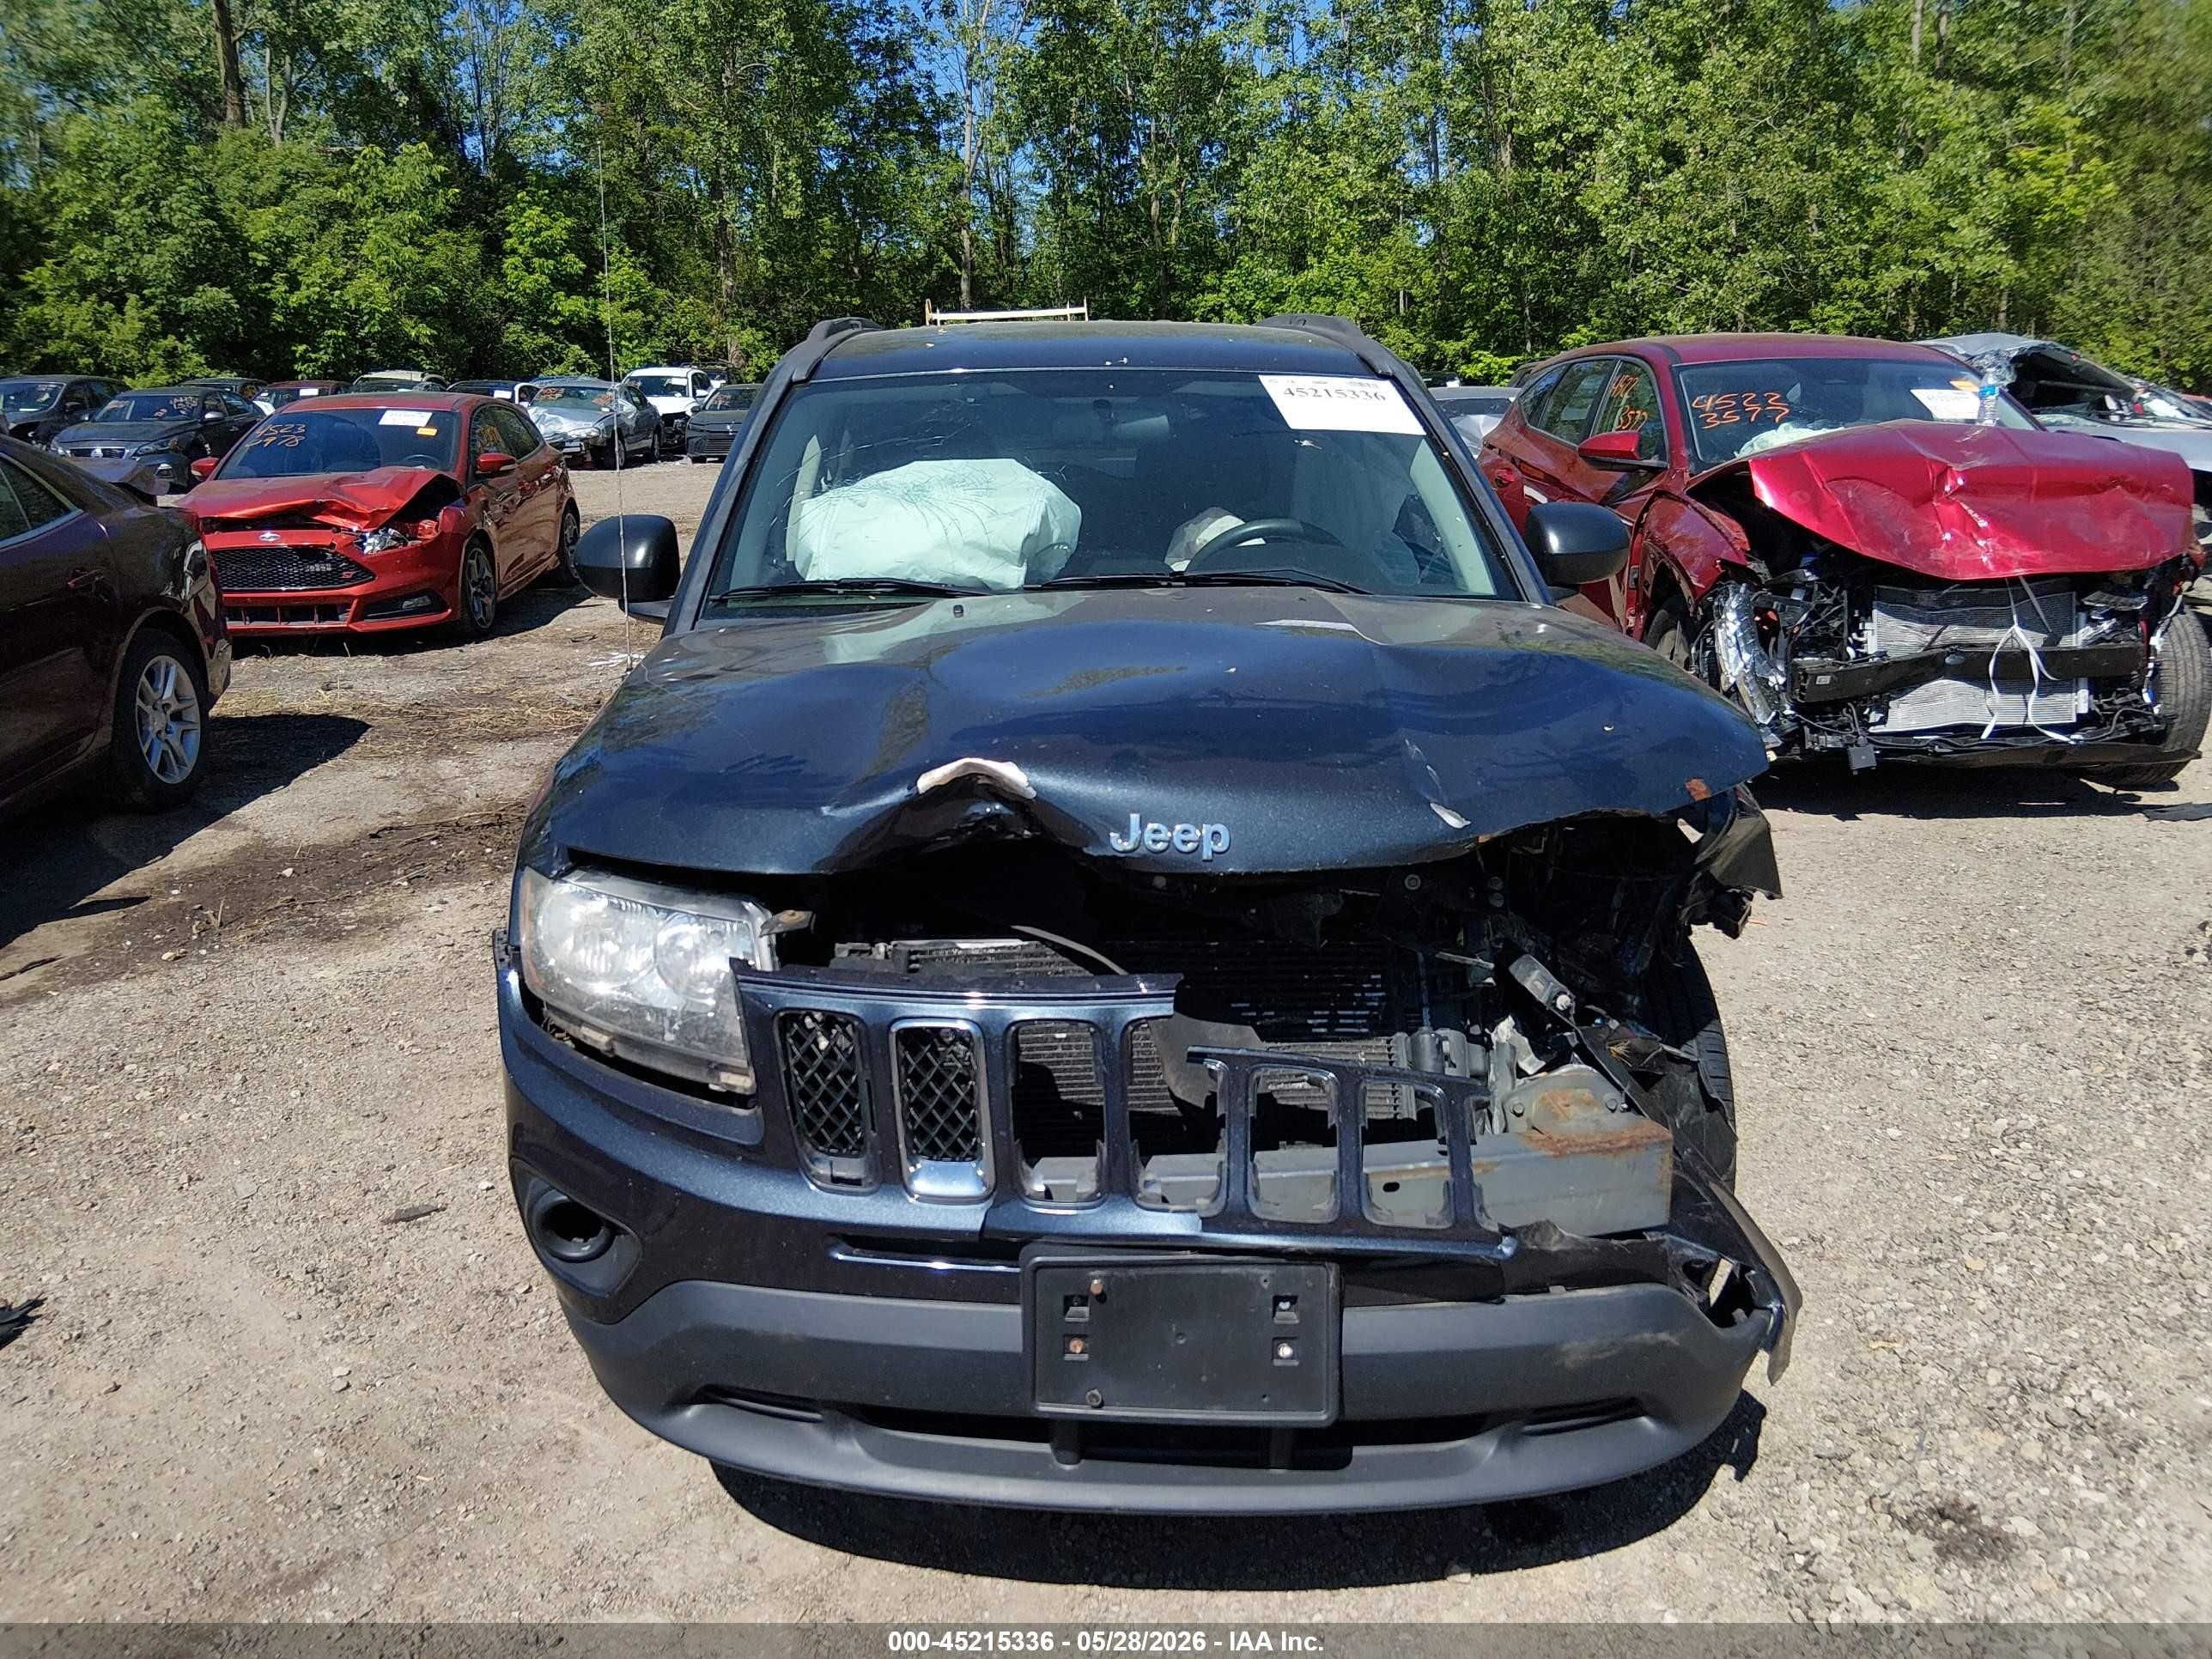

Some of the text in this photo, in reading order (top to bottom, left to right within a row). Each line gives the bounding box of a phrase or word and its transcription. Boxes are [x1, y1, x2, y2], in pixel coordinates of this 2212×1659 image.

[1283, 386, 1386, 402] 45215336
[1698, 406, 1790, 429] 3577
[1109, 813, 1231, 861] Jeep
